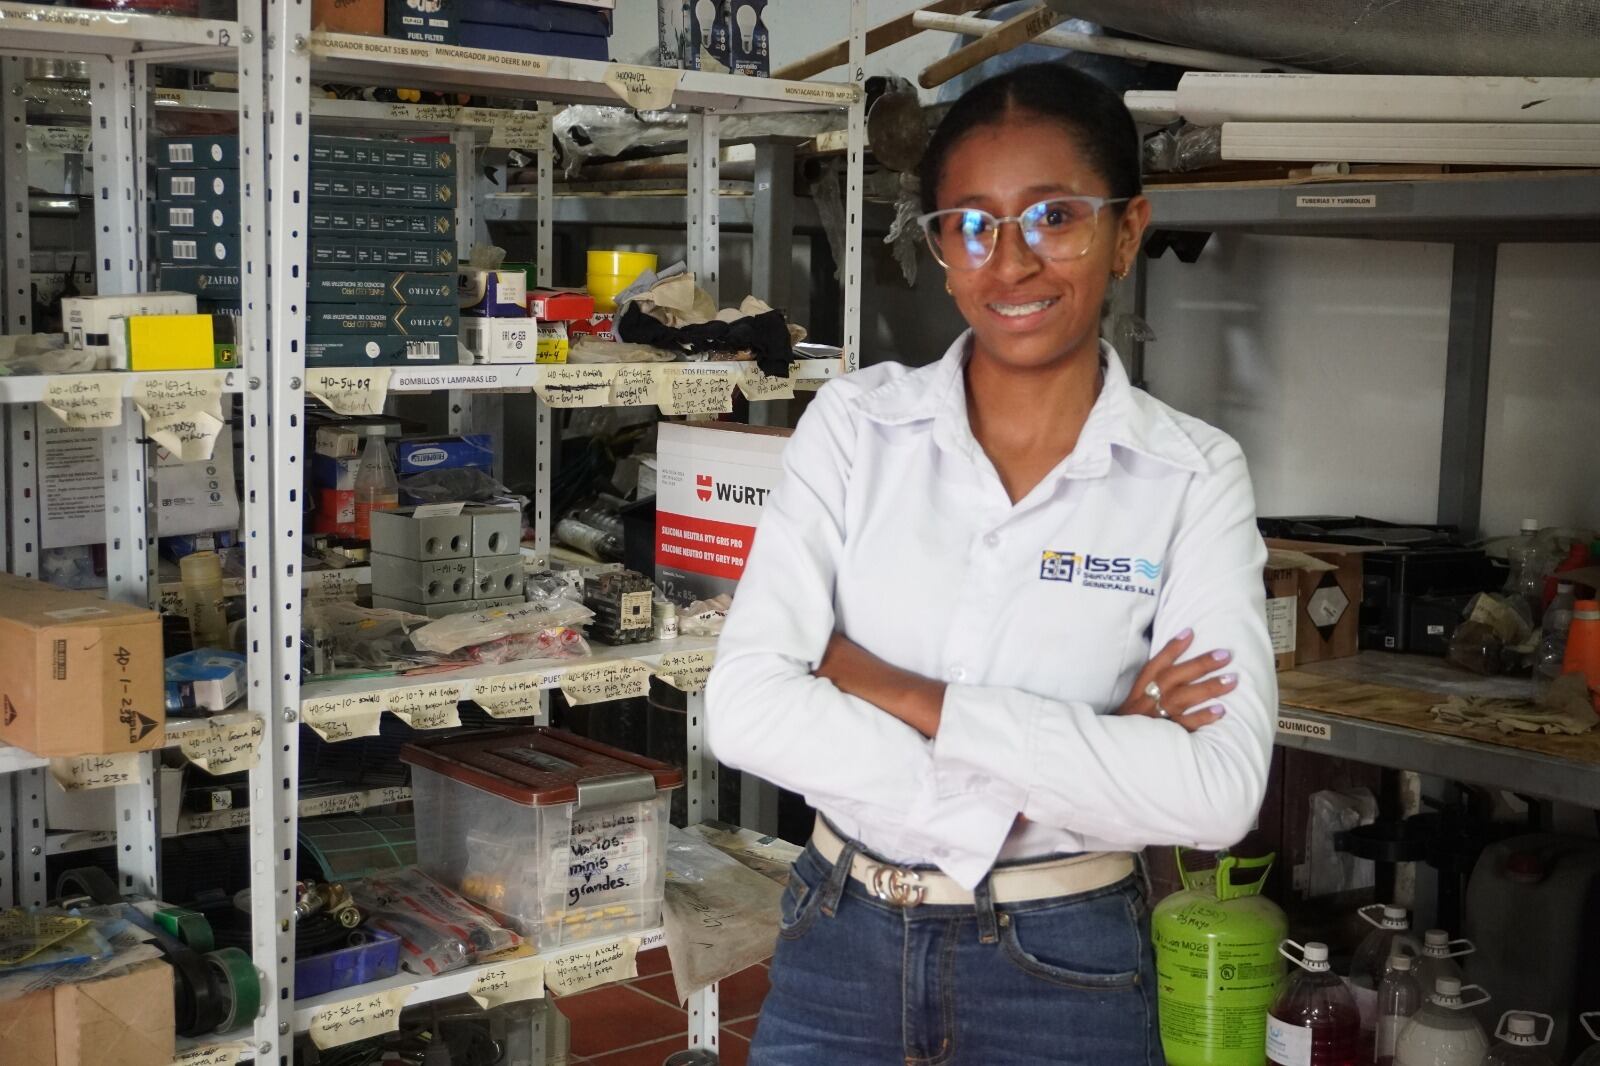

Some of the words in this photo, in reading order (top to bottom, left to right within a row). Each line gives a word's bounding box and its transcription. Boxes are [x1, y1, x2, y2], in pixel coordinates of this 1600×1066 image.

[407, 32, 424, 40] FUEL
[424, 33, 444, 42] FILTER
[364, 44, 392, 54] BOBCAT
[435, 48, 486, 61] MINICARGADOR
[501, 56, 520, 66] DEERE
[521, 60, 532, 68] MP
[207, 275, 239, 286] ZAFIRO
[408, 287, 441, 296] ZAFIRO
[400, 376, 441, 386] BOMBILLOS
[441, 376, 446, 385] Y
[447, 375, 485, 384] LAMPARAS
[485, 375, 498, 384] LED
[716, 482, 771, 507] WÜRT
[661, 525, 683, 539] SILICONA
[683, 529, 704, 542] NEUTRA
[704, 532, 716, 543] RTV
[716, 534, 730, 547] GRIS
[730, 536, 743, 548] PRO
[661, 543, 682, 556] SILICONE
[682, 546, 703, 560] NEUTRO
[703, 550, 715, 561] RTV
[715, 552, 731, 565] GREY
[731, 555, 744, 567] PRO
[1082, 580, 1136, 593] GENERALES
[1277, 719, 1327, 736] QUIMICOS
[569, 857, 609, 876] minis
